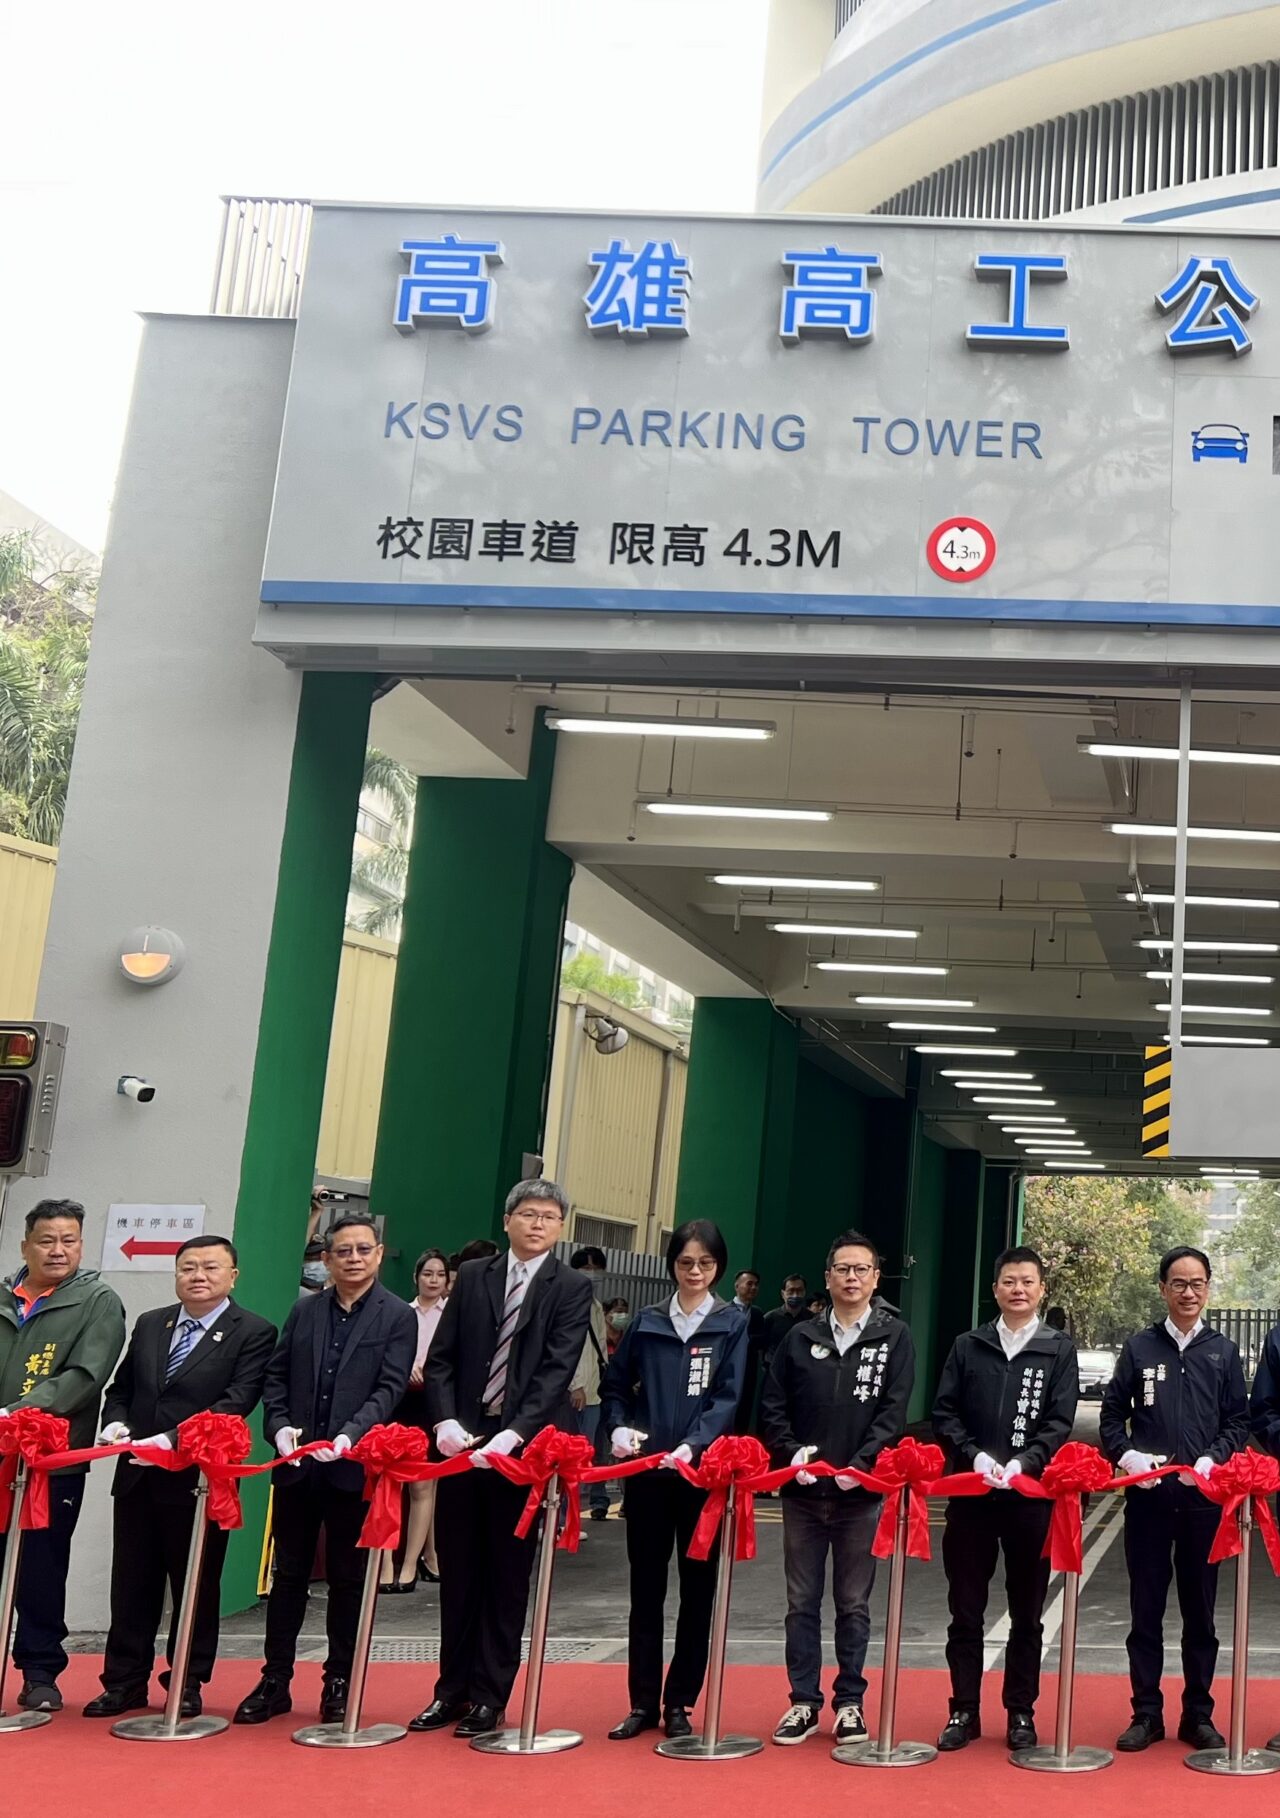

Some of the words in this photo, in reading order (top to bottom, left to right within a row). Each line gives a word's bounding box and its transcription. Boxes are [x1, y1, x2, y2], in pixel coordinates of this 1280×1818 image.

[383, 401, 525, 443] KSVS
[570, 405, 807, 453] PARKING
[852, 415, 1045, 460] TOWER
[376, 515, 580, 564] 校園車道
[609, 521, 709, 568] 限高
[722, 528, 842, 569] 4.3M
[942, 539, 981, 560] 4.3m
[116, 1217, 195, 1229] 機車停車區
